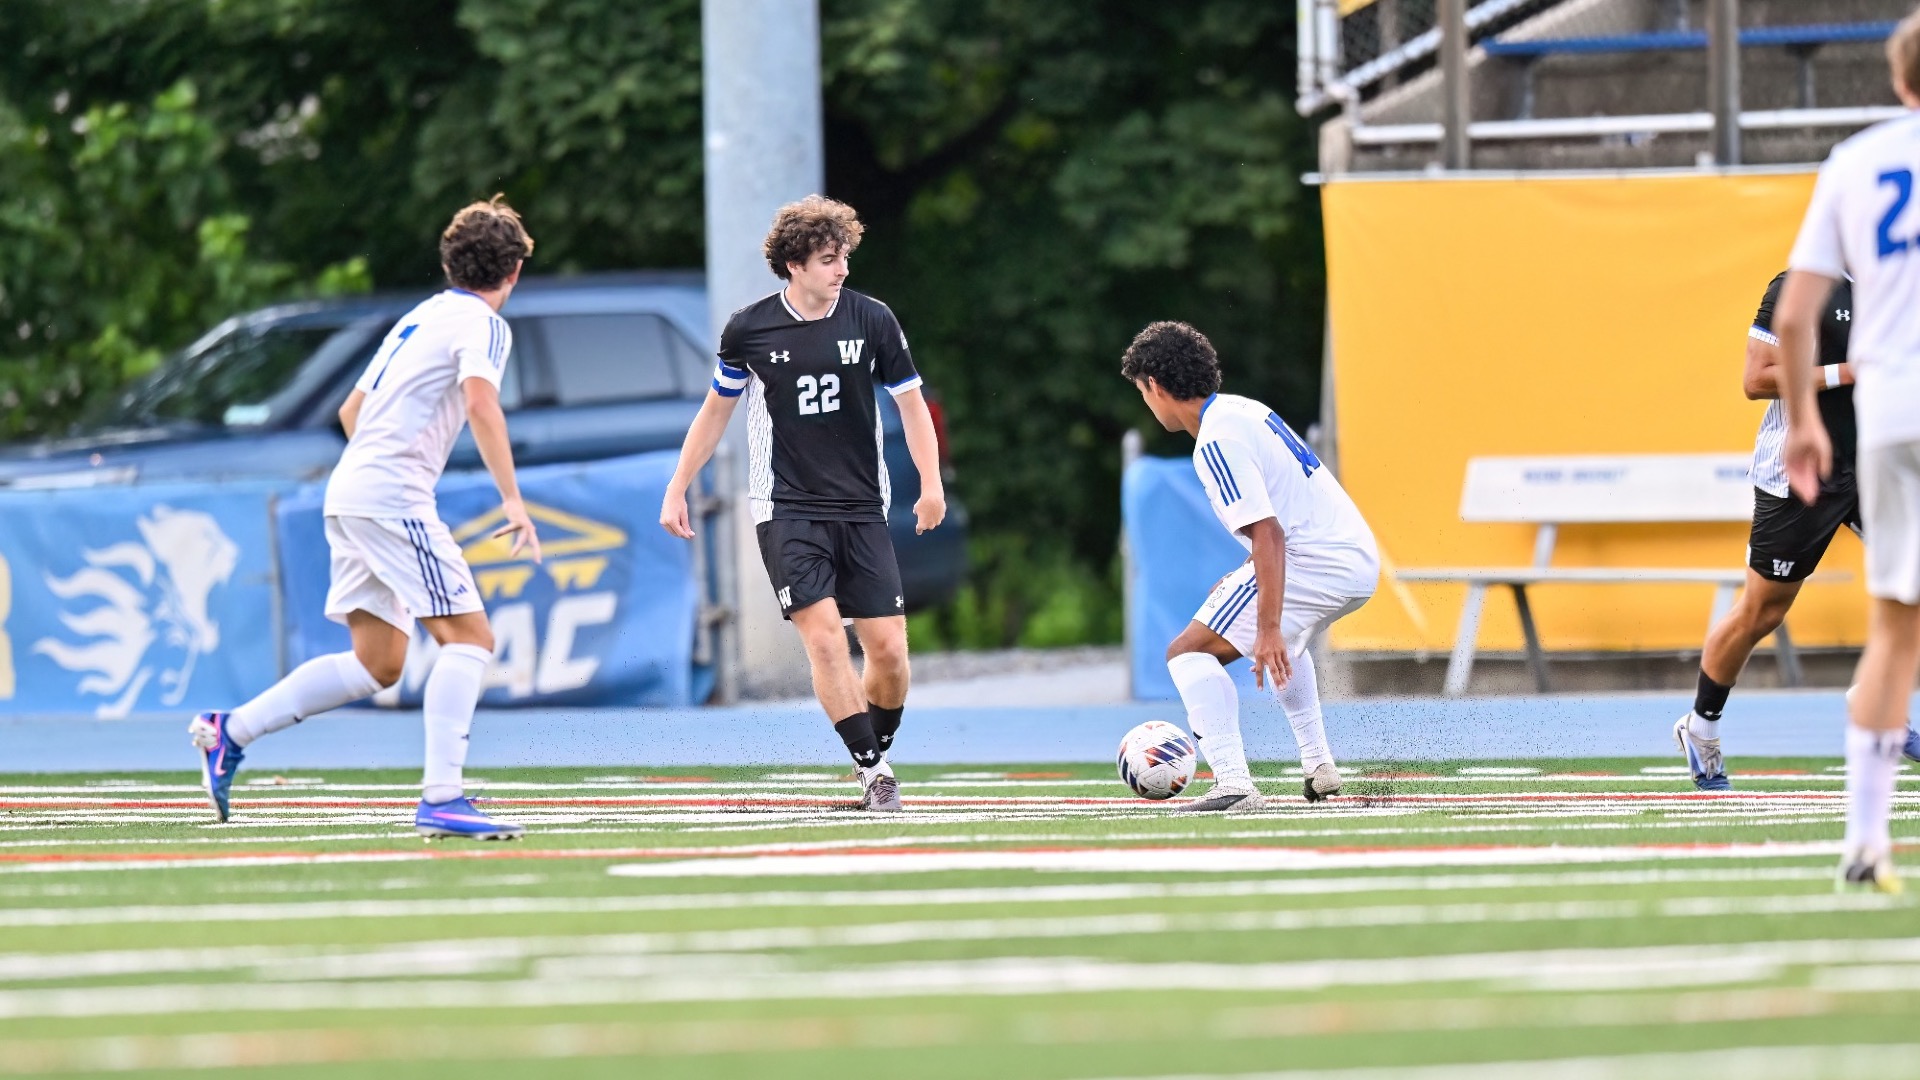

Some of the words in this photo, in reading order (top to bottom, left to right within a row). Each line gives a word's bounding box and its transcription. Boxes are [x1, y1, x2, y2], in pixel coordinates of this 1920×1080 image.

[1878, 170, 1920, 258] 2
[837, 339, 865, 365] W
[796, 373, 841, 416] 22
[1772, 558, 1796, 577] W
